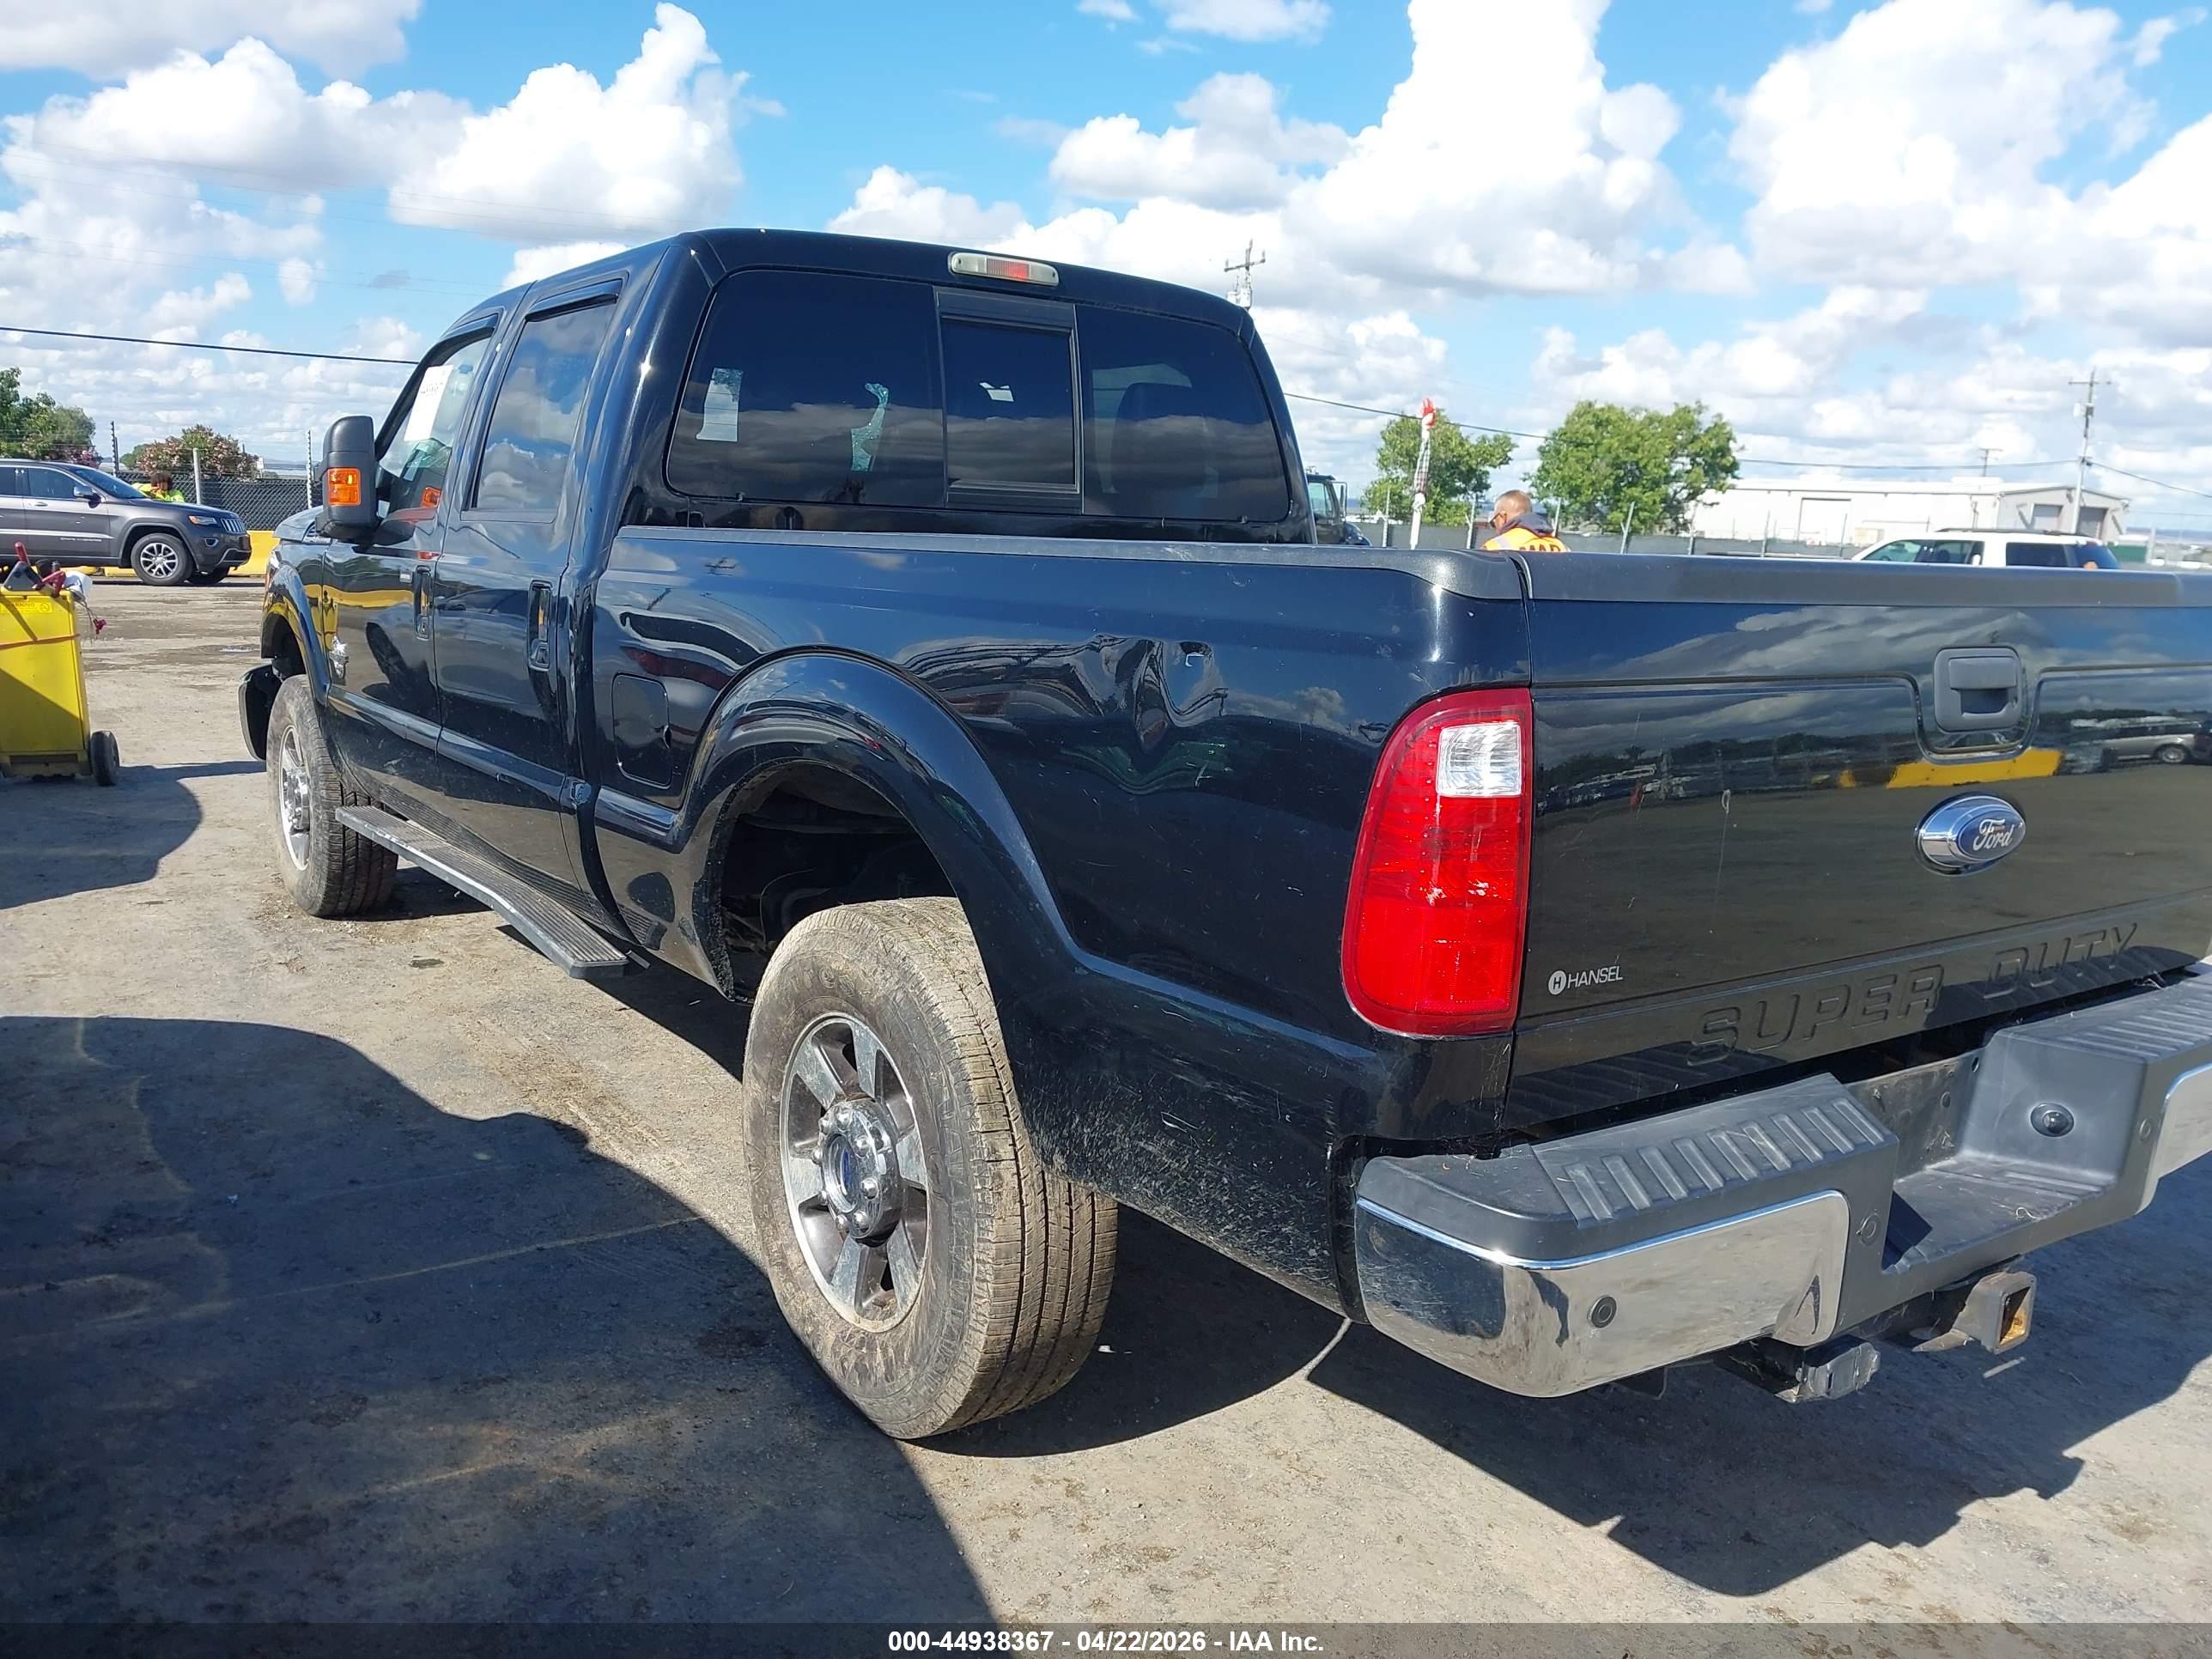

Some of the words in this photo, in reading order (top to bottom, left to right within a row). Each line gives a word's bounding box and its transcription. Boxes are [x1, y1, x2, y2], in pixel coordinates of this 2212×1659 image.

[1972, 818, 2014, 851] Ford
[1567, 965, 1624, 989] HANSEL
[1686, 963, 1944, 1066] SUPER
[1983, 921, 2138, 1000] DUTY
